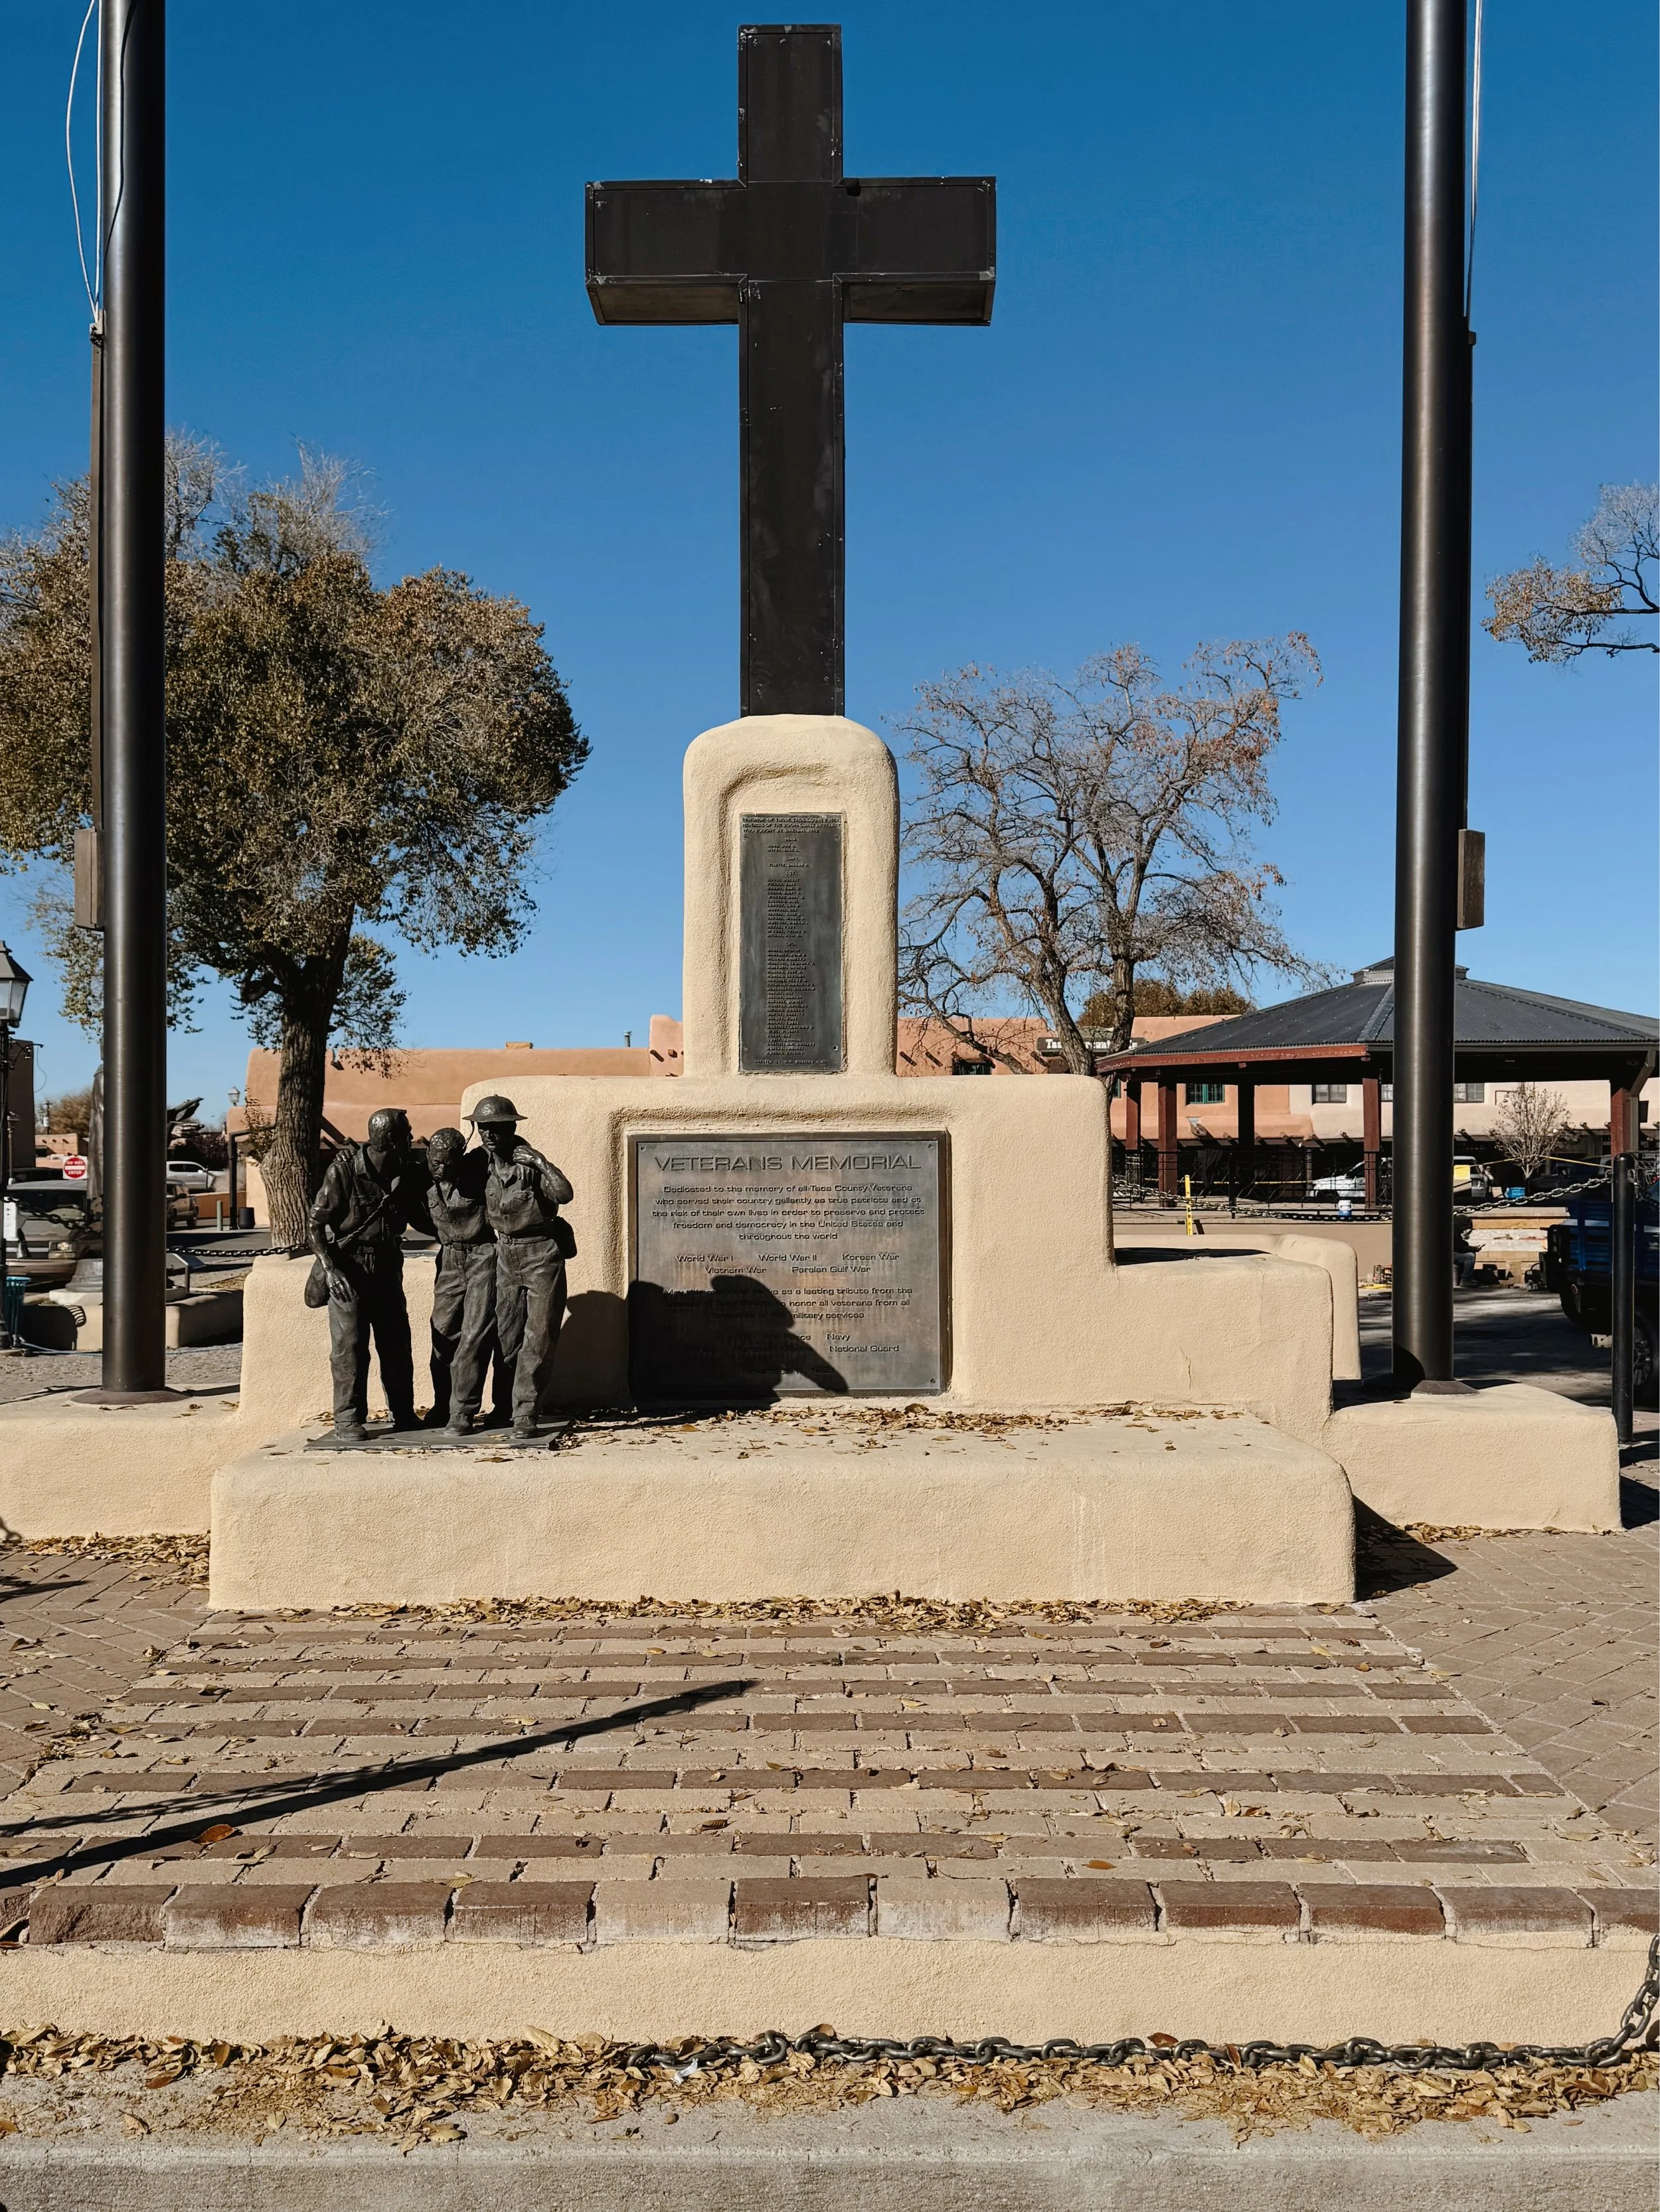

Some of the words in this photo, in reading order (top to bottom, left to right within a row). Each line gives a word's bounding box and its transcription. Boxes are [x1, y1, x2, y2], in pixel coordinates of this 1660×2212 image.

[654, 1156, 782, 1171] VETERANS
[791, 1154, 922, 1170] MEMORIAL
[775, 1197, 811, 1206] gallantly
[738, 1233, 792, 1241] throughout
[790, 1312, 823, 1320] military
[827, 1333, 851, 1342] Navy
